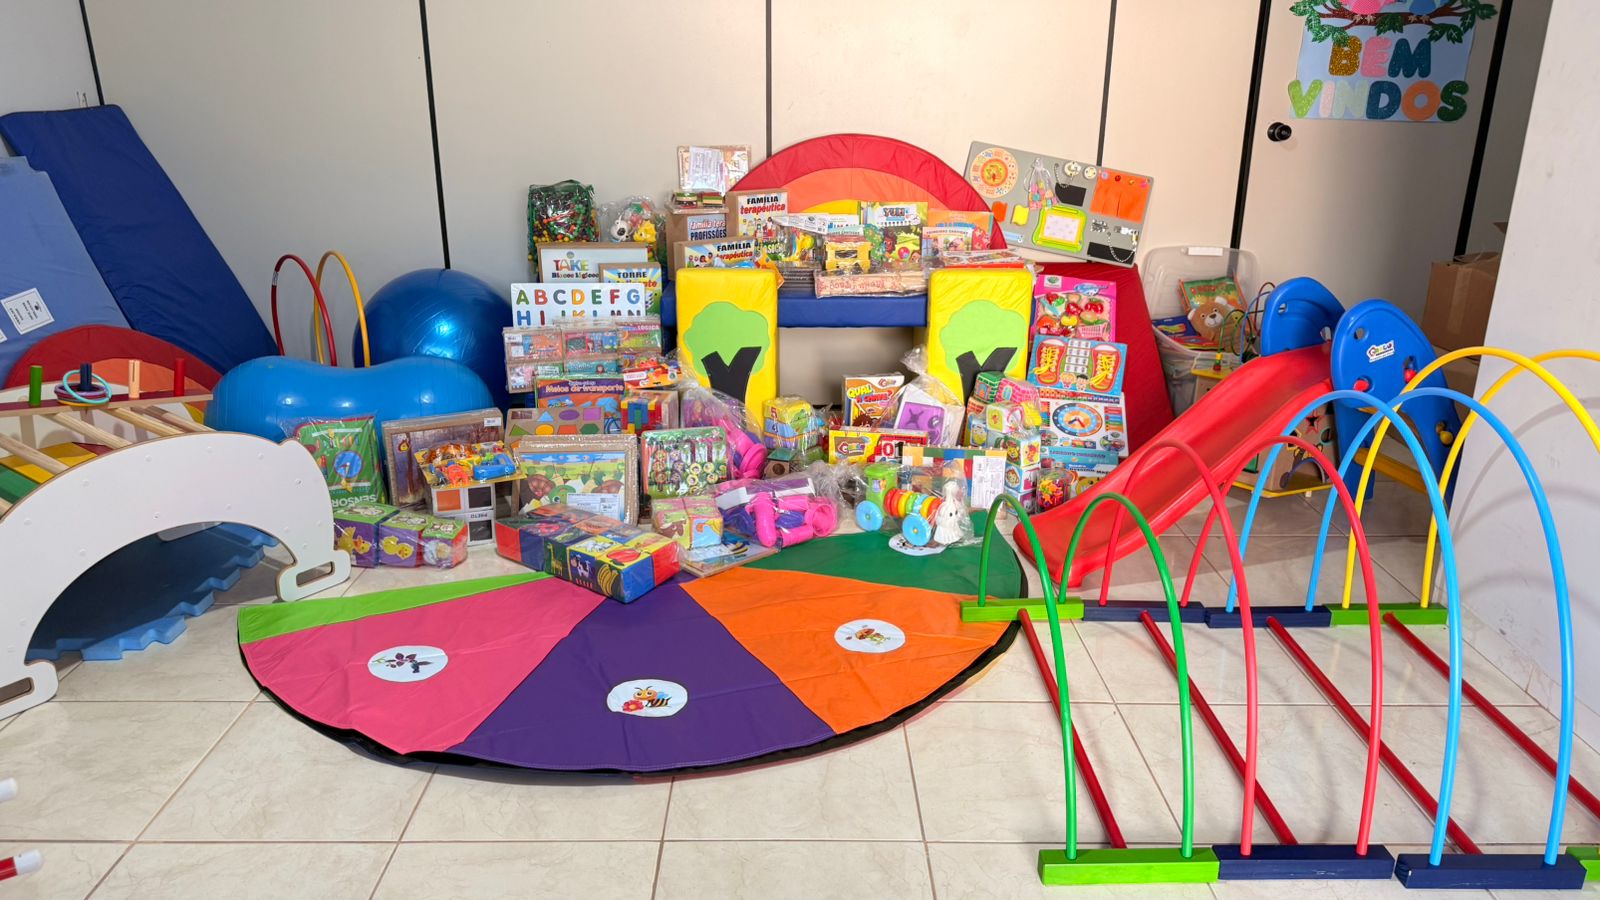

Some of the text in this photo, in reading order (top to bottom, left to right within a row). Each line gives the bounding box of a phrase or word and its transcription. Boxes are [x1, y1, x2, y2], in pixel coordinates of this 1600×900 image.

[1328, 35, 1432, 78] BEM
[1288, 79, 1469, 122] VINDOS
[746, 195, 779, 205] FAMÍLIA
[690, 228, 727, 241] PROFISSÕES
[553, 259, 589, 272] TAKE
[616, 271, 648, 279] TORRE
[516, 289, 640, 305] A B C D E F G
[517, 310, 531, 326] H
[847, 385, 873, 398] QUAL
